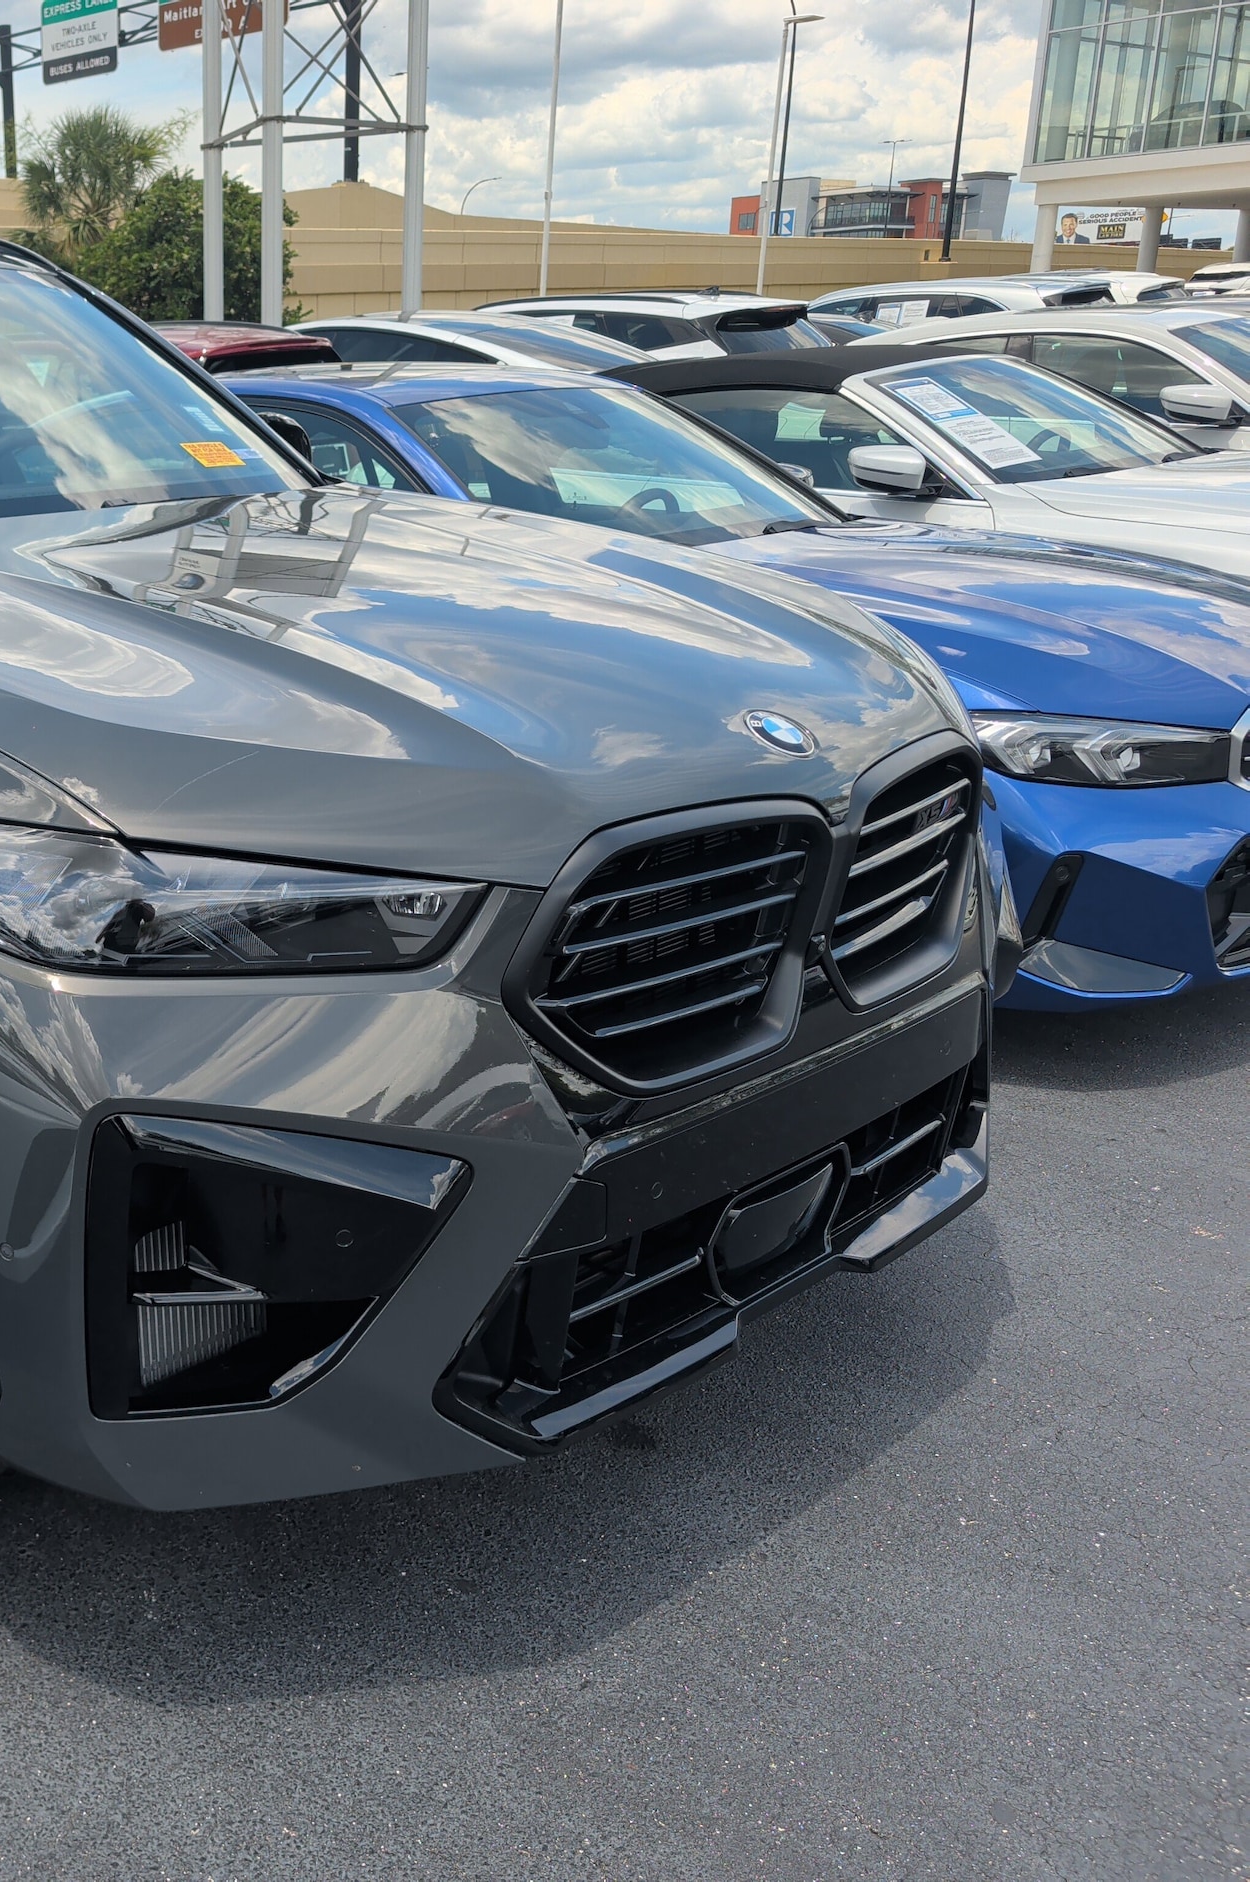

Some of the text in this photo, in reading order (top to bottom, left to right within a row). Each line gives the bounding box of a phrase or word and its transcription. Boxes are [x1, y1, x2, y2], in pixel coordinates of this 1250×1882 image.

[44, 0, 114, 18] EXPRESS LAN
[164, 6, 203, 23] Maitla
[62, 21, 96, 37] TWO-AXLE
[51, 32, 108, 52] VEHICLES ONLY
[49, 56, 110, 77] BUSES ALLOWED
